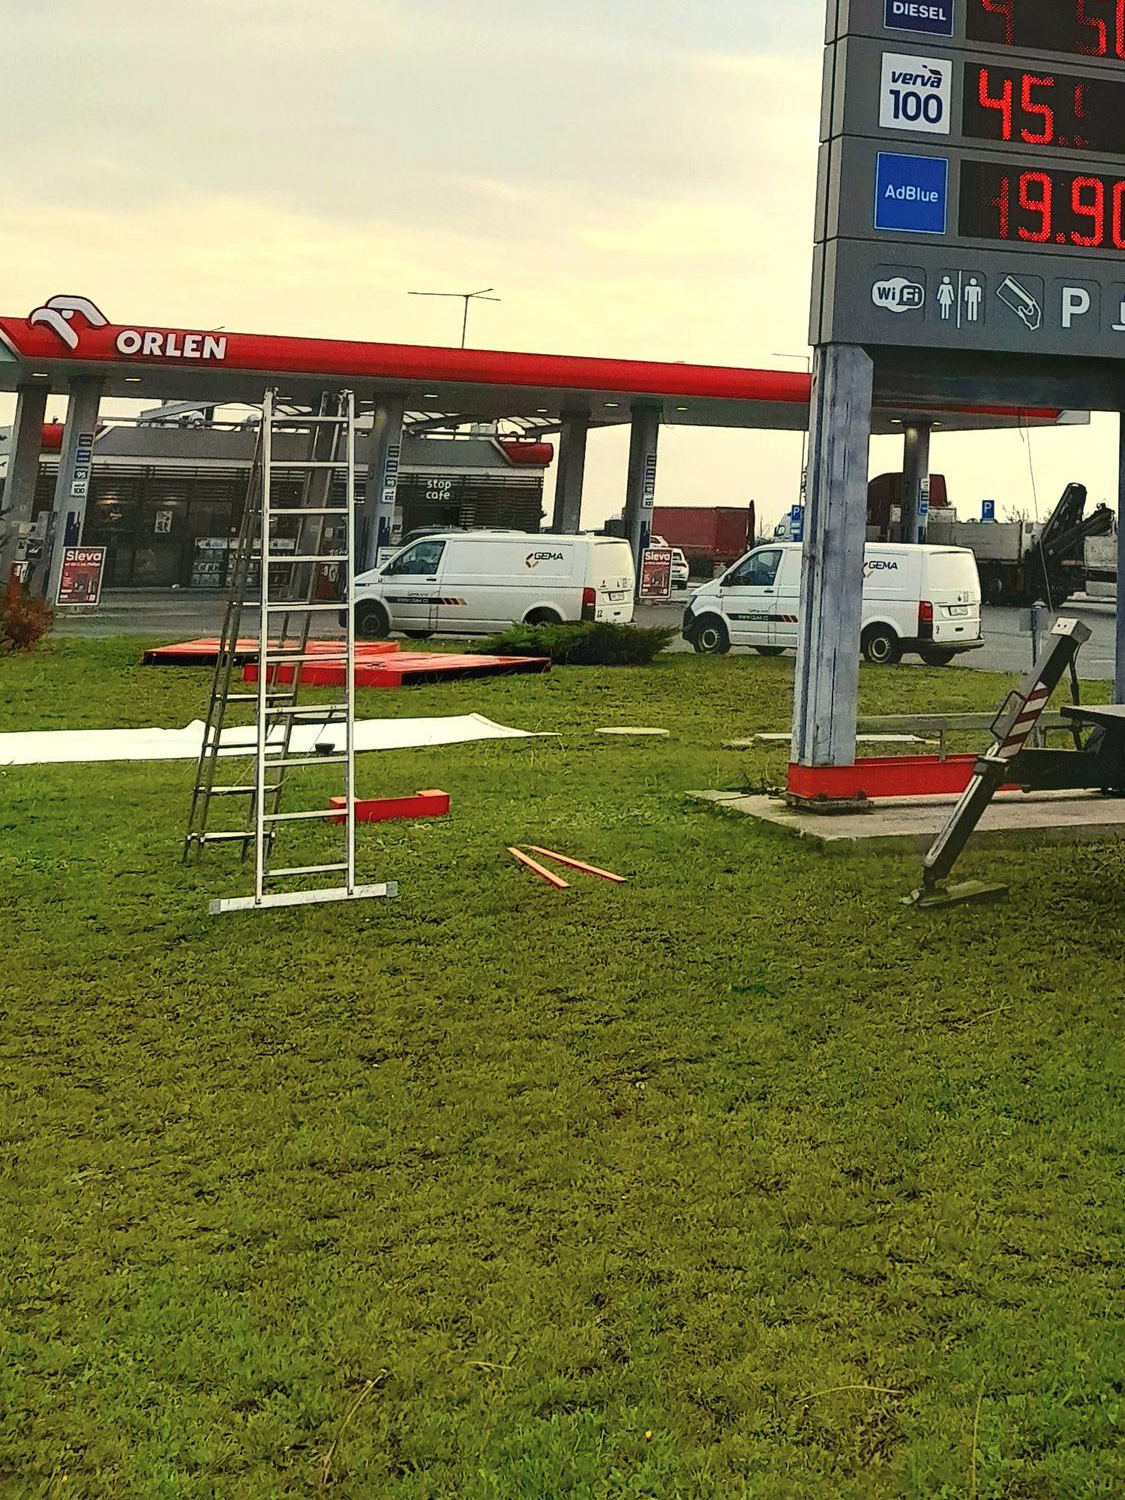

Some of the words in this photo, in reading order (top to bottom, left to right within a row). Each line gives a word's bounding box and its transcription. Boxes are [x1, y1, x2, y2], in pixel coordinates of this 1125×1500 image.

[892, 1, 947, 22] DIESEL
[890, 69, 943, 90] verva
[888, 88, 943, 125] 100
[884, 184, 939, 203] AdBlue
[1061, 286, 1091, 328] P
[115, 329, 228, 361] ORLEN
[427, 480, 452, 491] stop
[426, 491, 451, 501] cafe
[66, 549, 103, 561] Sleva
[533, 551, 564, 560] GEMA
[644, 551, 671, 561] Sleva
[868, 560, 898, 570] GEMA
